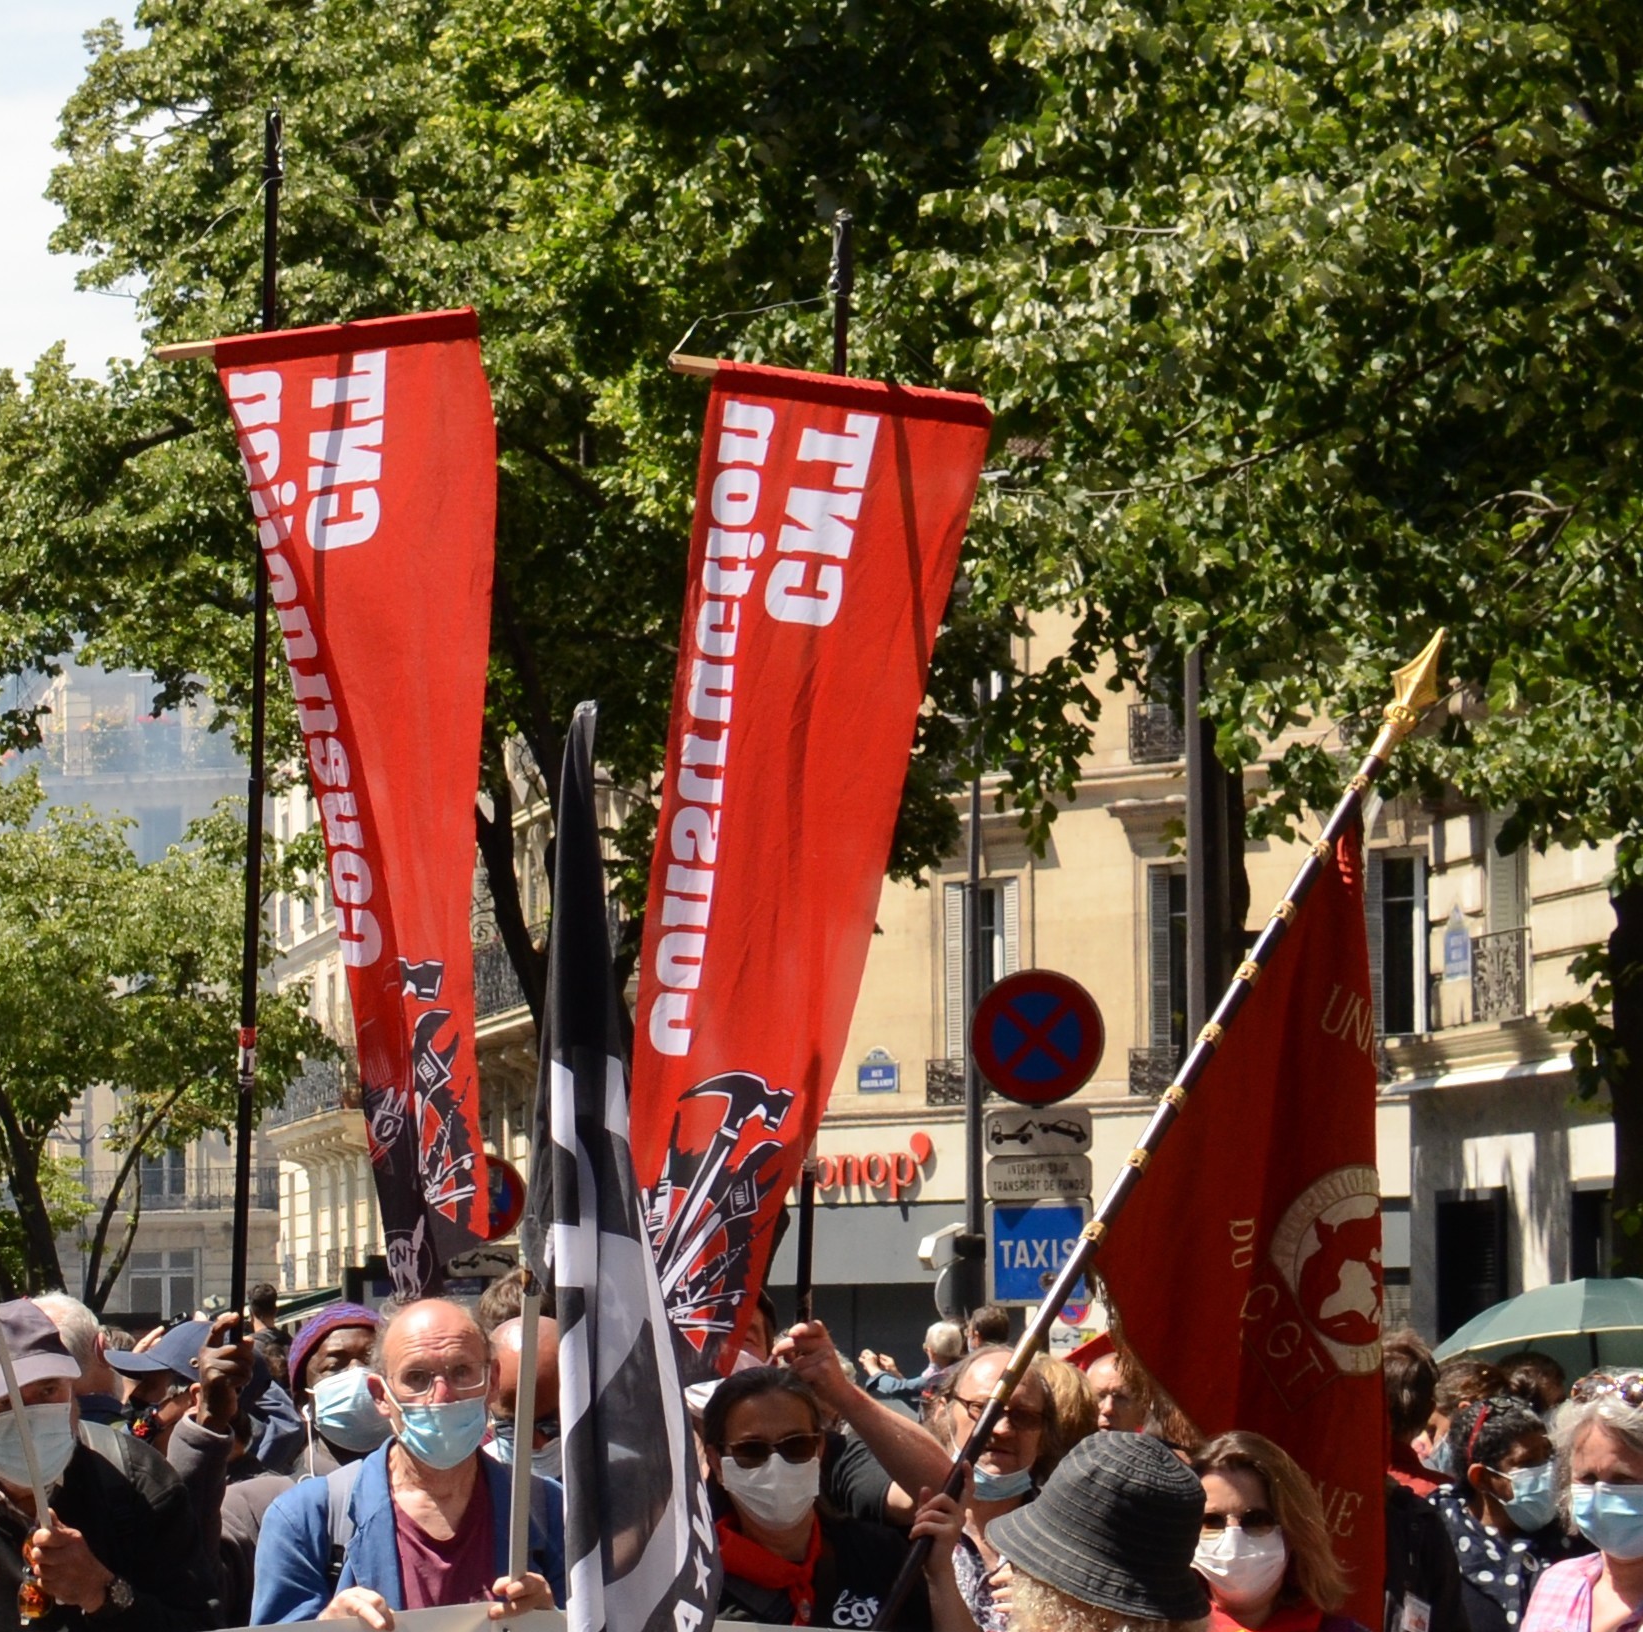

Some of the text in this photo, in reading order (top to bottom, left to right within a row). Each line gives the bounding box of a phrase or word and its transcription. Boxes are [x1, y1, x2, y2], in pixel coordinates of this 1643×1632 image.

[815, 1131, 931, 1201] onop'
[993, 1180, 1041, 1192] TRANSPORT
[1043, 1179, 1055, 1191] DE
[389, 1245, 417, 1268] CNT
[999, 1238, 1078, 1269] TAXIS
[832, 1596, 880, 1628] cgt
